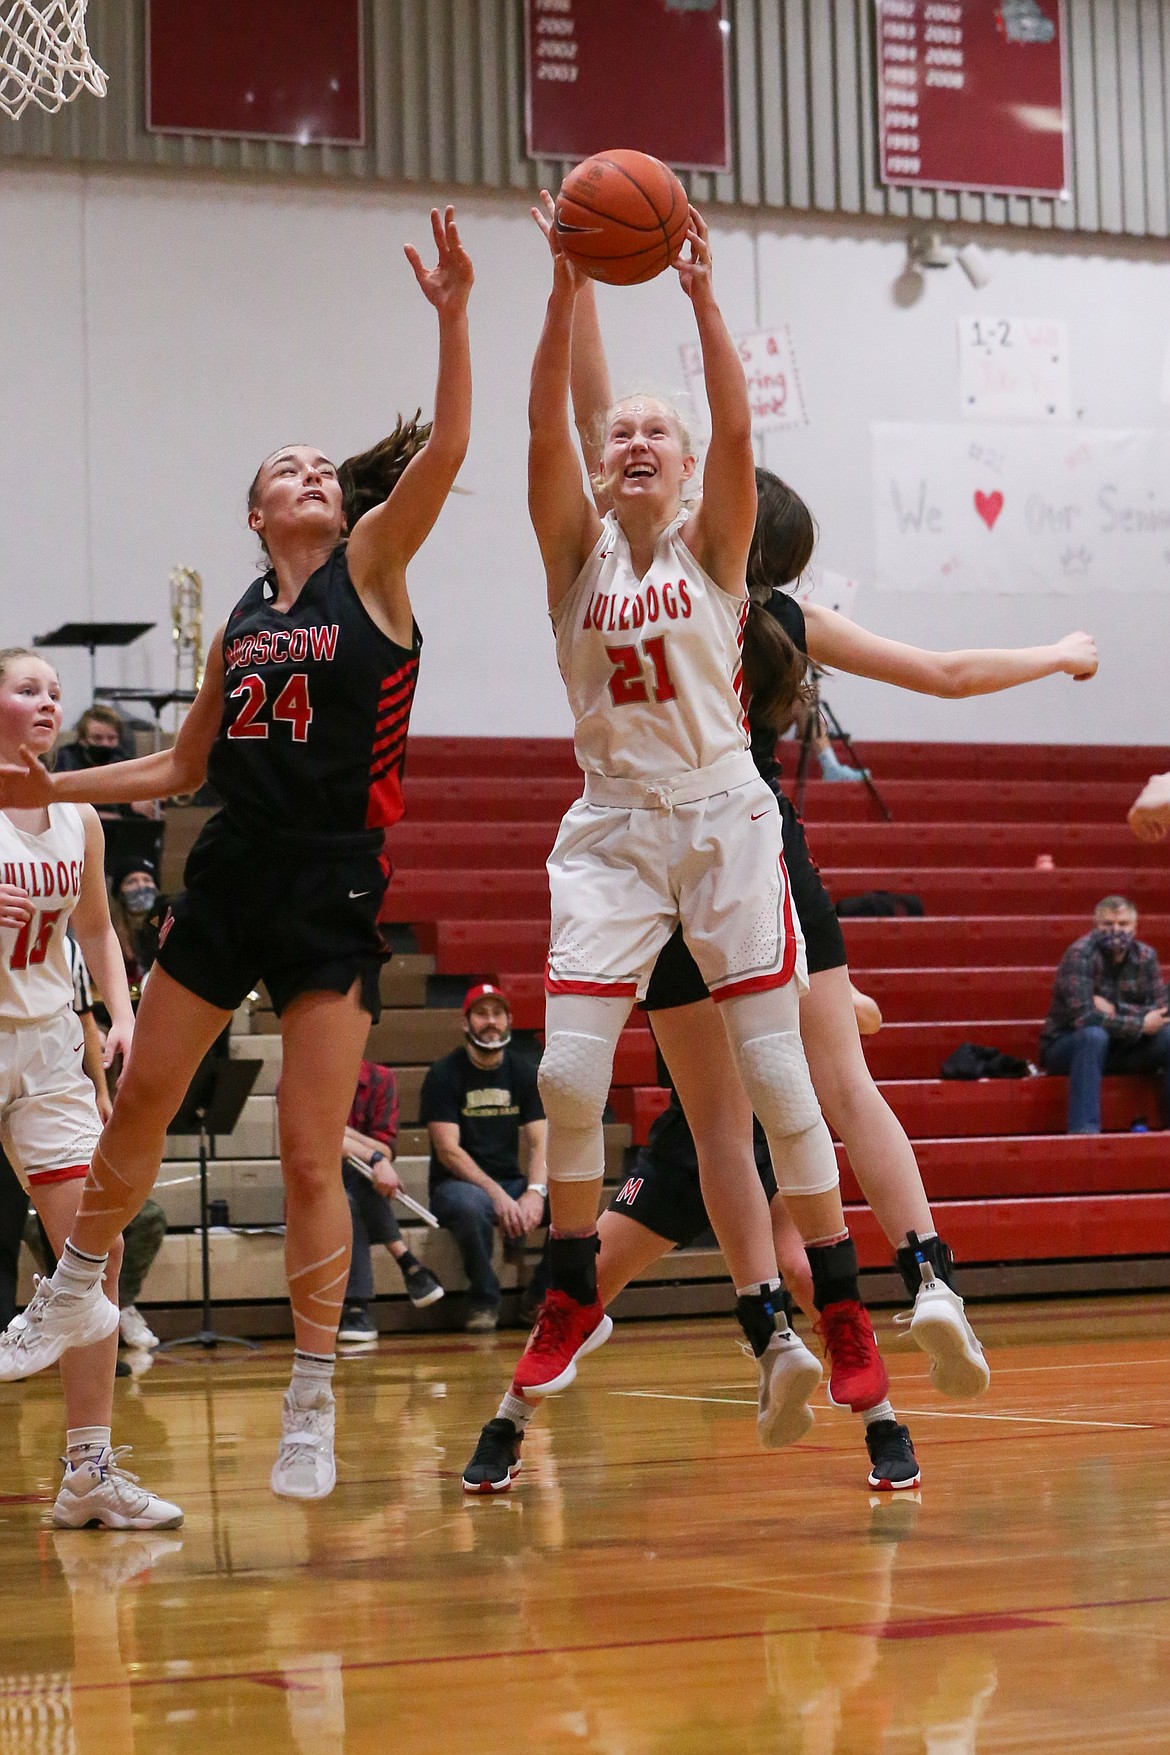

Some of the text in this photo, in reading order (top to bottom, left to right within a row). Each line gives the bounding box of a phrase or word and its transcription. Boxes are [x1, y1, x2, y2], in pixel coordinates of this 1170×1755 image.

[890, 478, 943, 535] We
[1024, 491, 1081, 536] Our
[225, 623, 340, 675] MOSCOW
[604, 634, 678, 708] 21
[227, 673, 313, 743] 24
[0, 860, 84, 897] ULLDOG
[9, 909, 63, 971] 15
[615, 1177, 644, 1206] M
